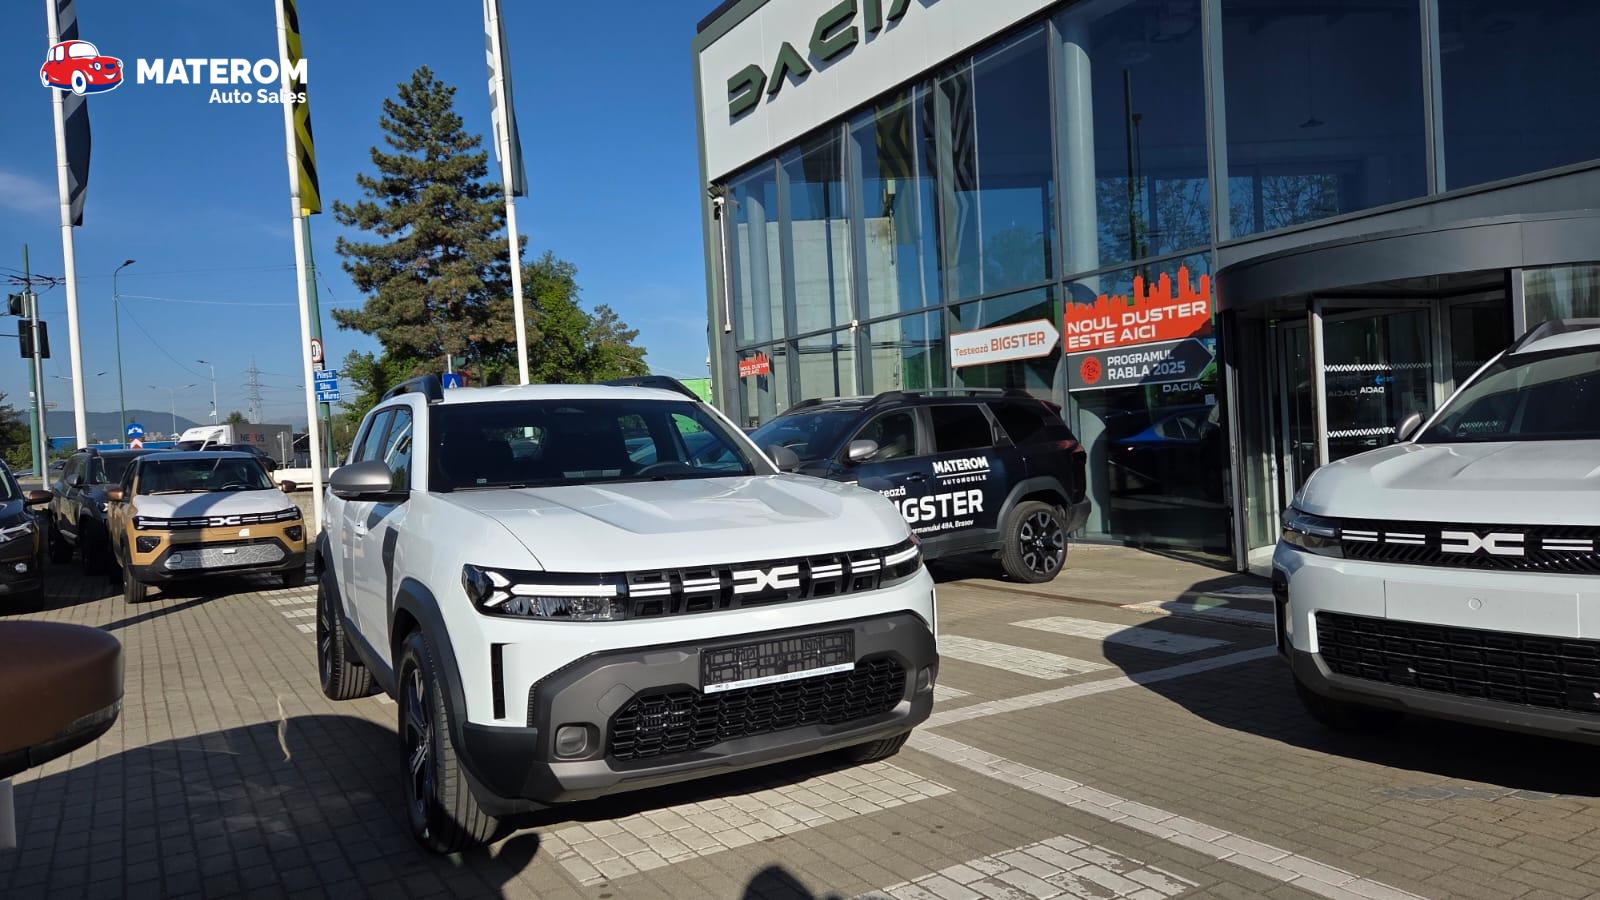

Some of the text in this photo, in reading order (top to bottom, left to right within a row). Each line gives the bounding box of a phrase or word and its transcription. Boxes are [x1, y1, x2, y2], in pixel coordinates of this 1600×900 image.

[727, 0, 910, 118] DACI
[1067, 301, 1207, 334] NOUL DUSTER
[991, 331, 1046, 352] BIGSTER
[1068, 325, 1156, 349] ESTE AICI
[1107, 349, 1175, 366] PROGRAMUL
[1108, 361, 1186, 380] RABLA 2025
[1162, 382, 1202, 393] DACIA
[932, 456, 989, 474] MATEROM
[942, 475, 987, 486] AUTOMOBILE
[879, 486, 906, 498] tează
